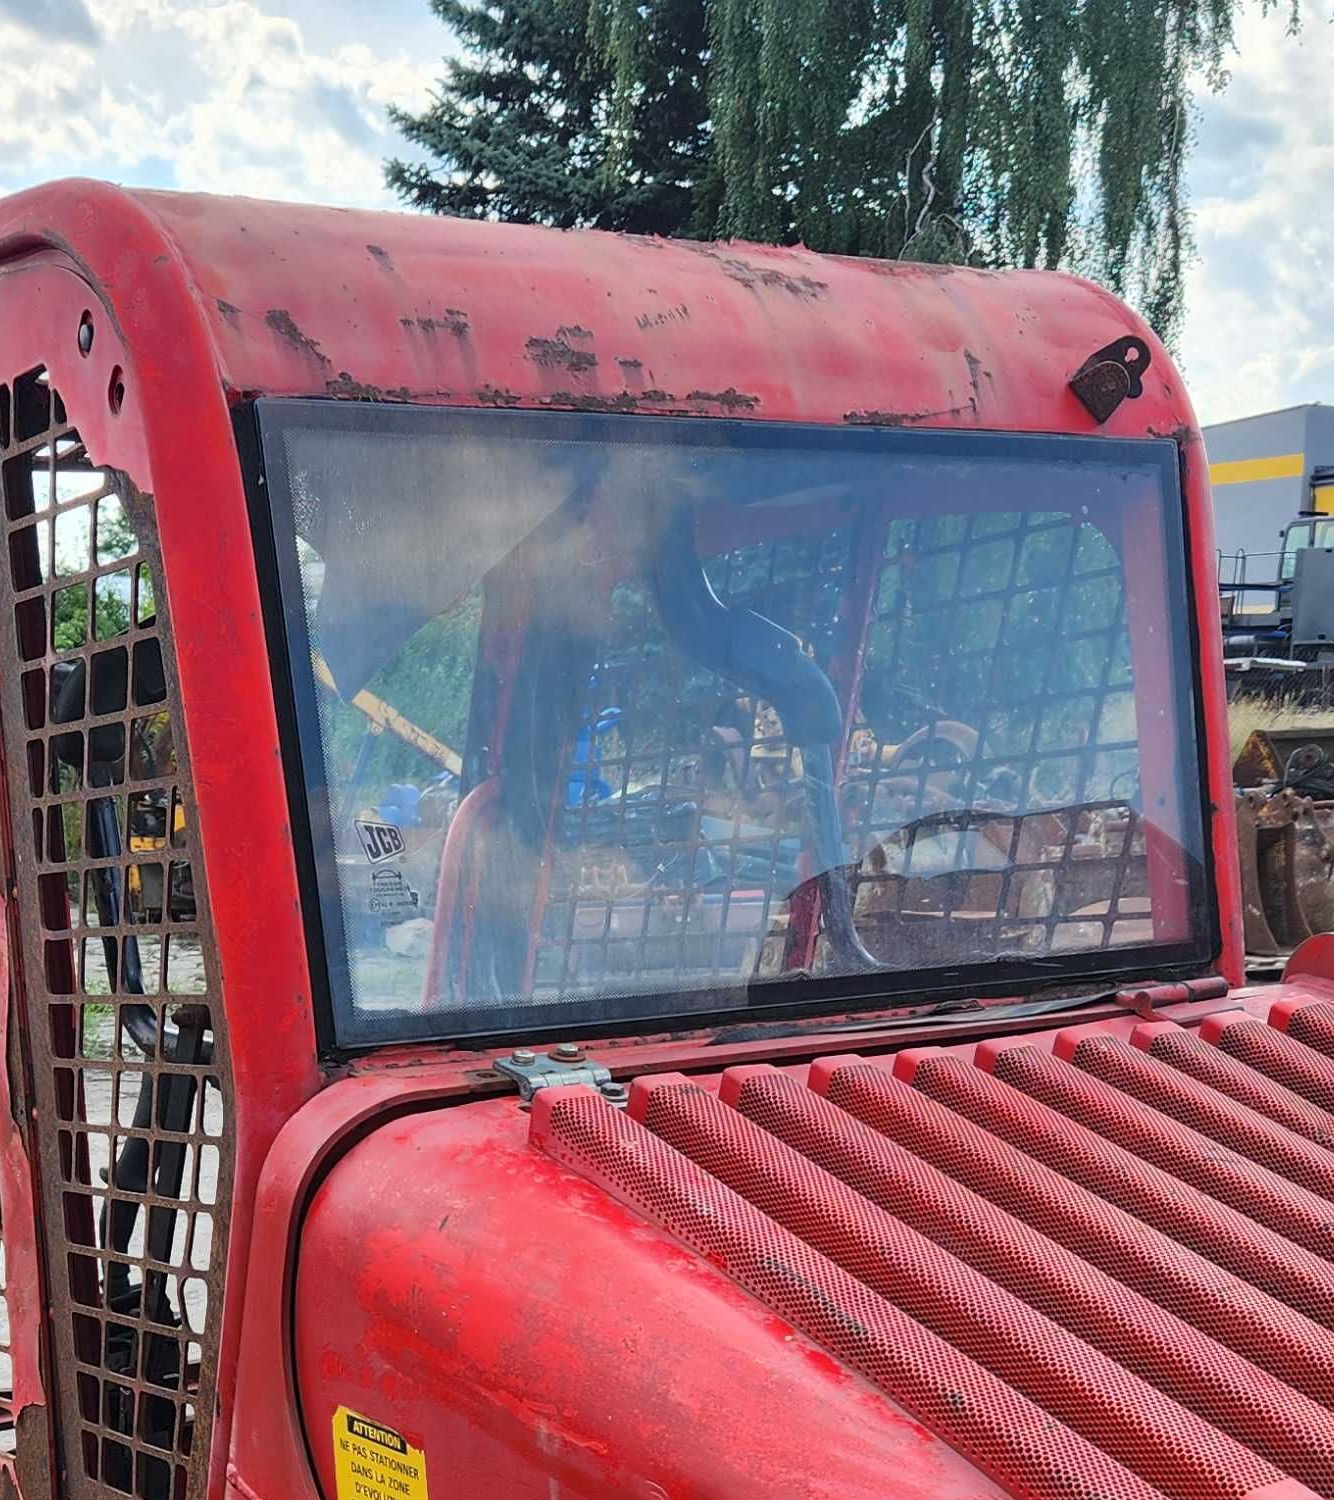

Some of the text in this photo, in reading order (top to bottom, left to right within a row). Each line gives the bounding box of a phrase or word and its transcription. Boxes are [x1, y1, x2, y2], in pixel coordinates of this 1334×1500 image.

[364, 825, 402, 859] JCB
[353, 1419, 402, 1450] ATTENTION
[339, 1438, 419, 1481] NE PAS STATIONNER
[351, 1461, 411, 1496] DANS LA ZONE
